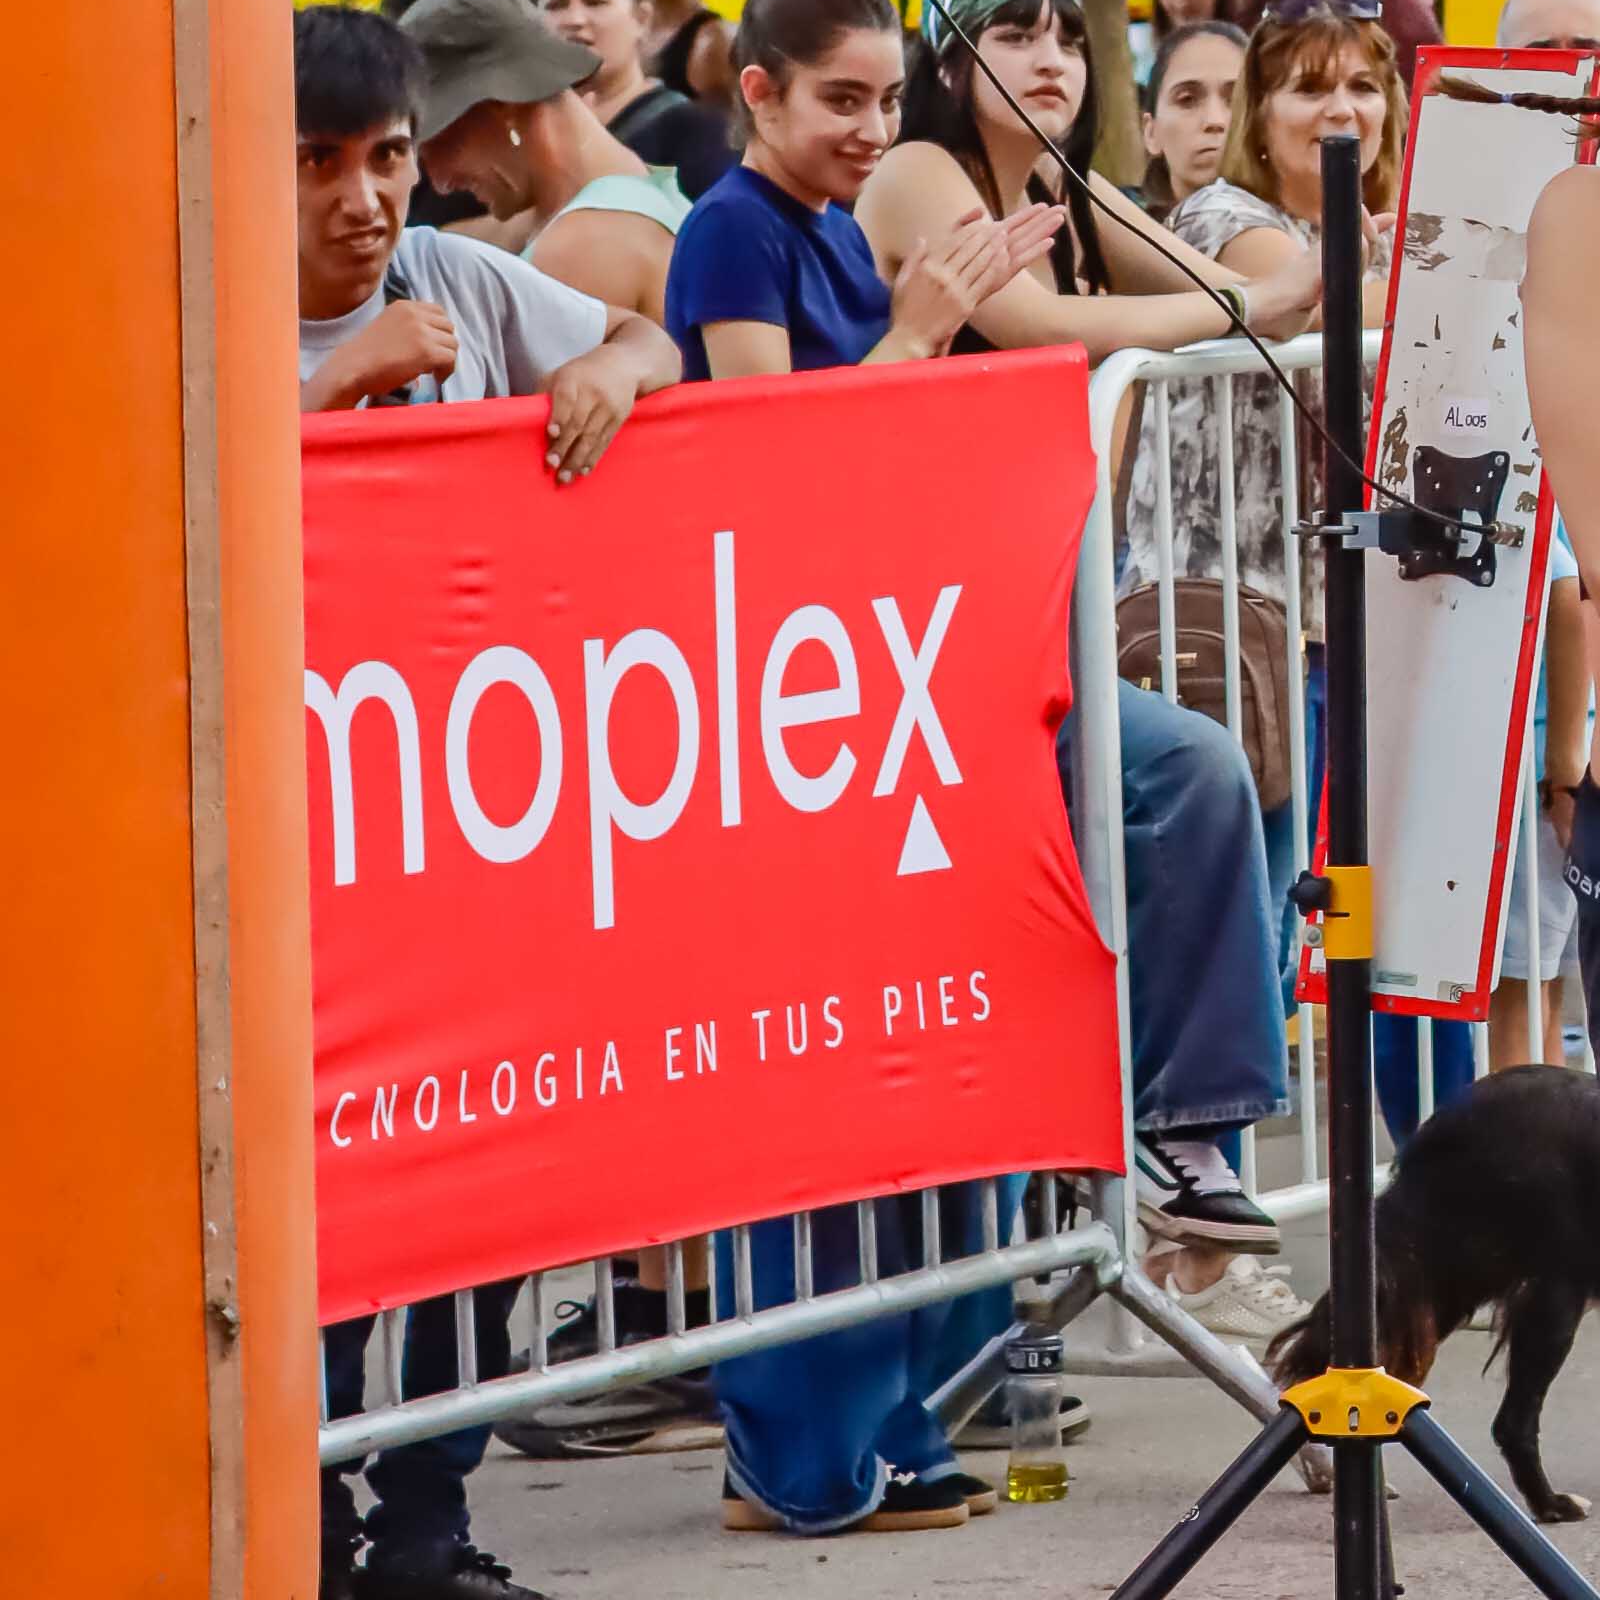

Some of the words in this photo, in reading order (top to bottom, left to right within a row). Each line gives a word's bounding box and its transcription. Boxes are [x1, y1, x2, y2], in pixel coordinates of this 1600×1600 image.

[304, 530, 964, 930] moplex
[329, 1040, 624, 1148] CNOLOGIA
[664, 1020, 719, 1081] EN
[751, 996, 845, 1061] TUS
[883, 970, 992, 1037] PIES
